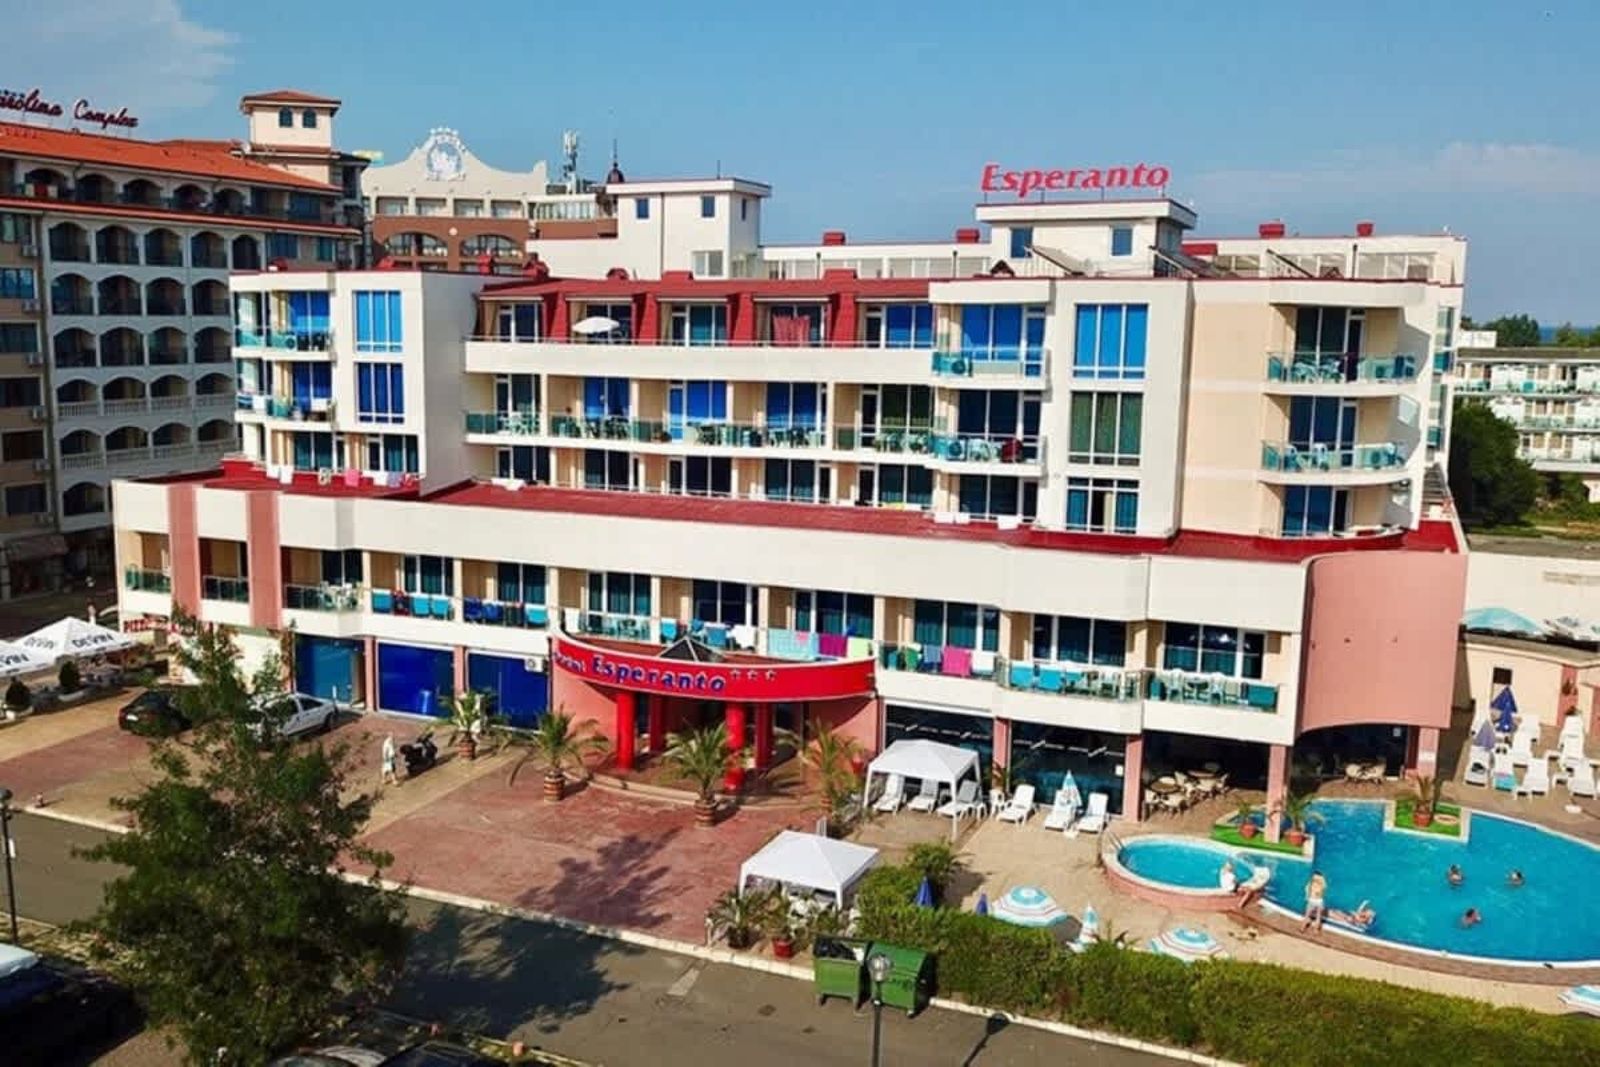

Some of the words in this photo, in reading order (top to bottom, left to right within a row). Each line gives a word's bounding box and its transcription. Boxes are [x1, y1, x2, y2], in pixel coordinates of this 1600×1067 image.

[74, 99, 139, 129] Complex
[981, 162, 1170, 198] Esperanto
[592, 654, 726, 692] Esperanto
